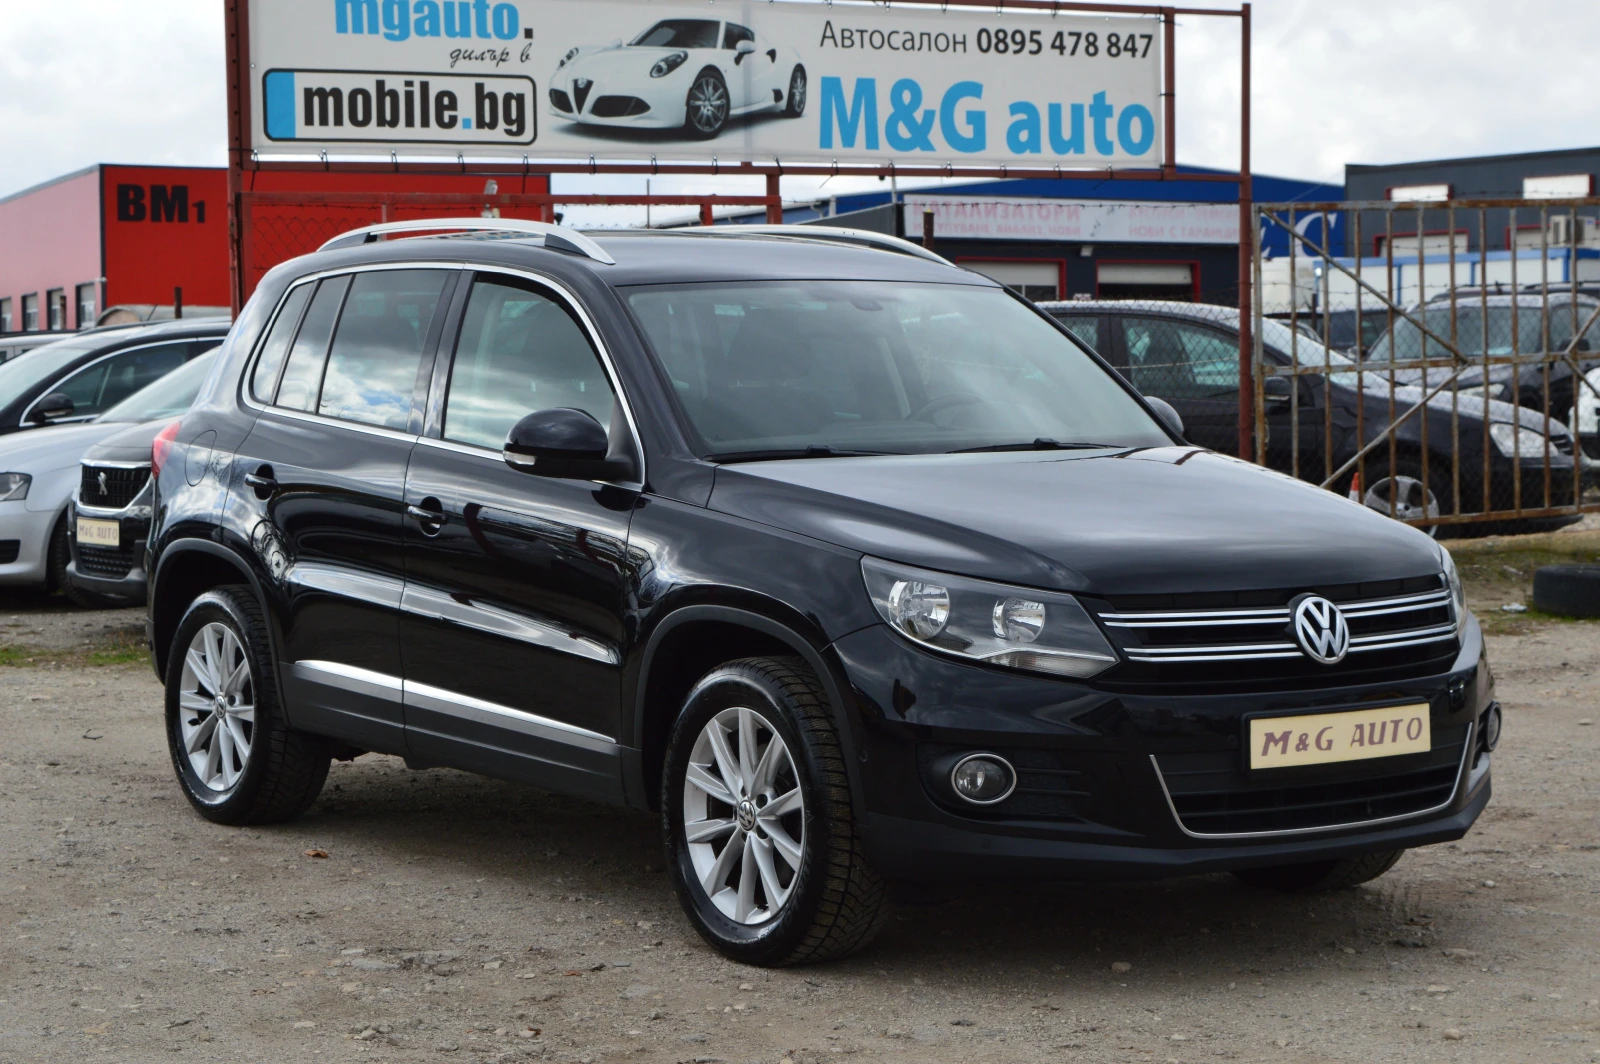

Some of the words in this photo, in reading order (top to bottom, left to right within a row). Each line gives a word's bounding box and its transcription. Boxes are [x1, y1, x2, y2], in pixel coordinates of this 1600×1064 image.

[449, 47, 511, 68] дилър
[519, 42, 533, 63] в
[820, 20, 967, 53] Автосалон
[976, 28, 1043, 55] 0895
[1051, 31, 1099, 58] 478
[1106, 33, 1154, 59] 847
[303, 79, 526, 137] mobile.bg
[819, 76, 987, 153] M&G
[1006, 90, 1155, 156] auto
[912, 200, 1081, 221] КАТАЛИЗАТОРИ
[1350, 717, 1423, 748] AUTO
